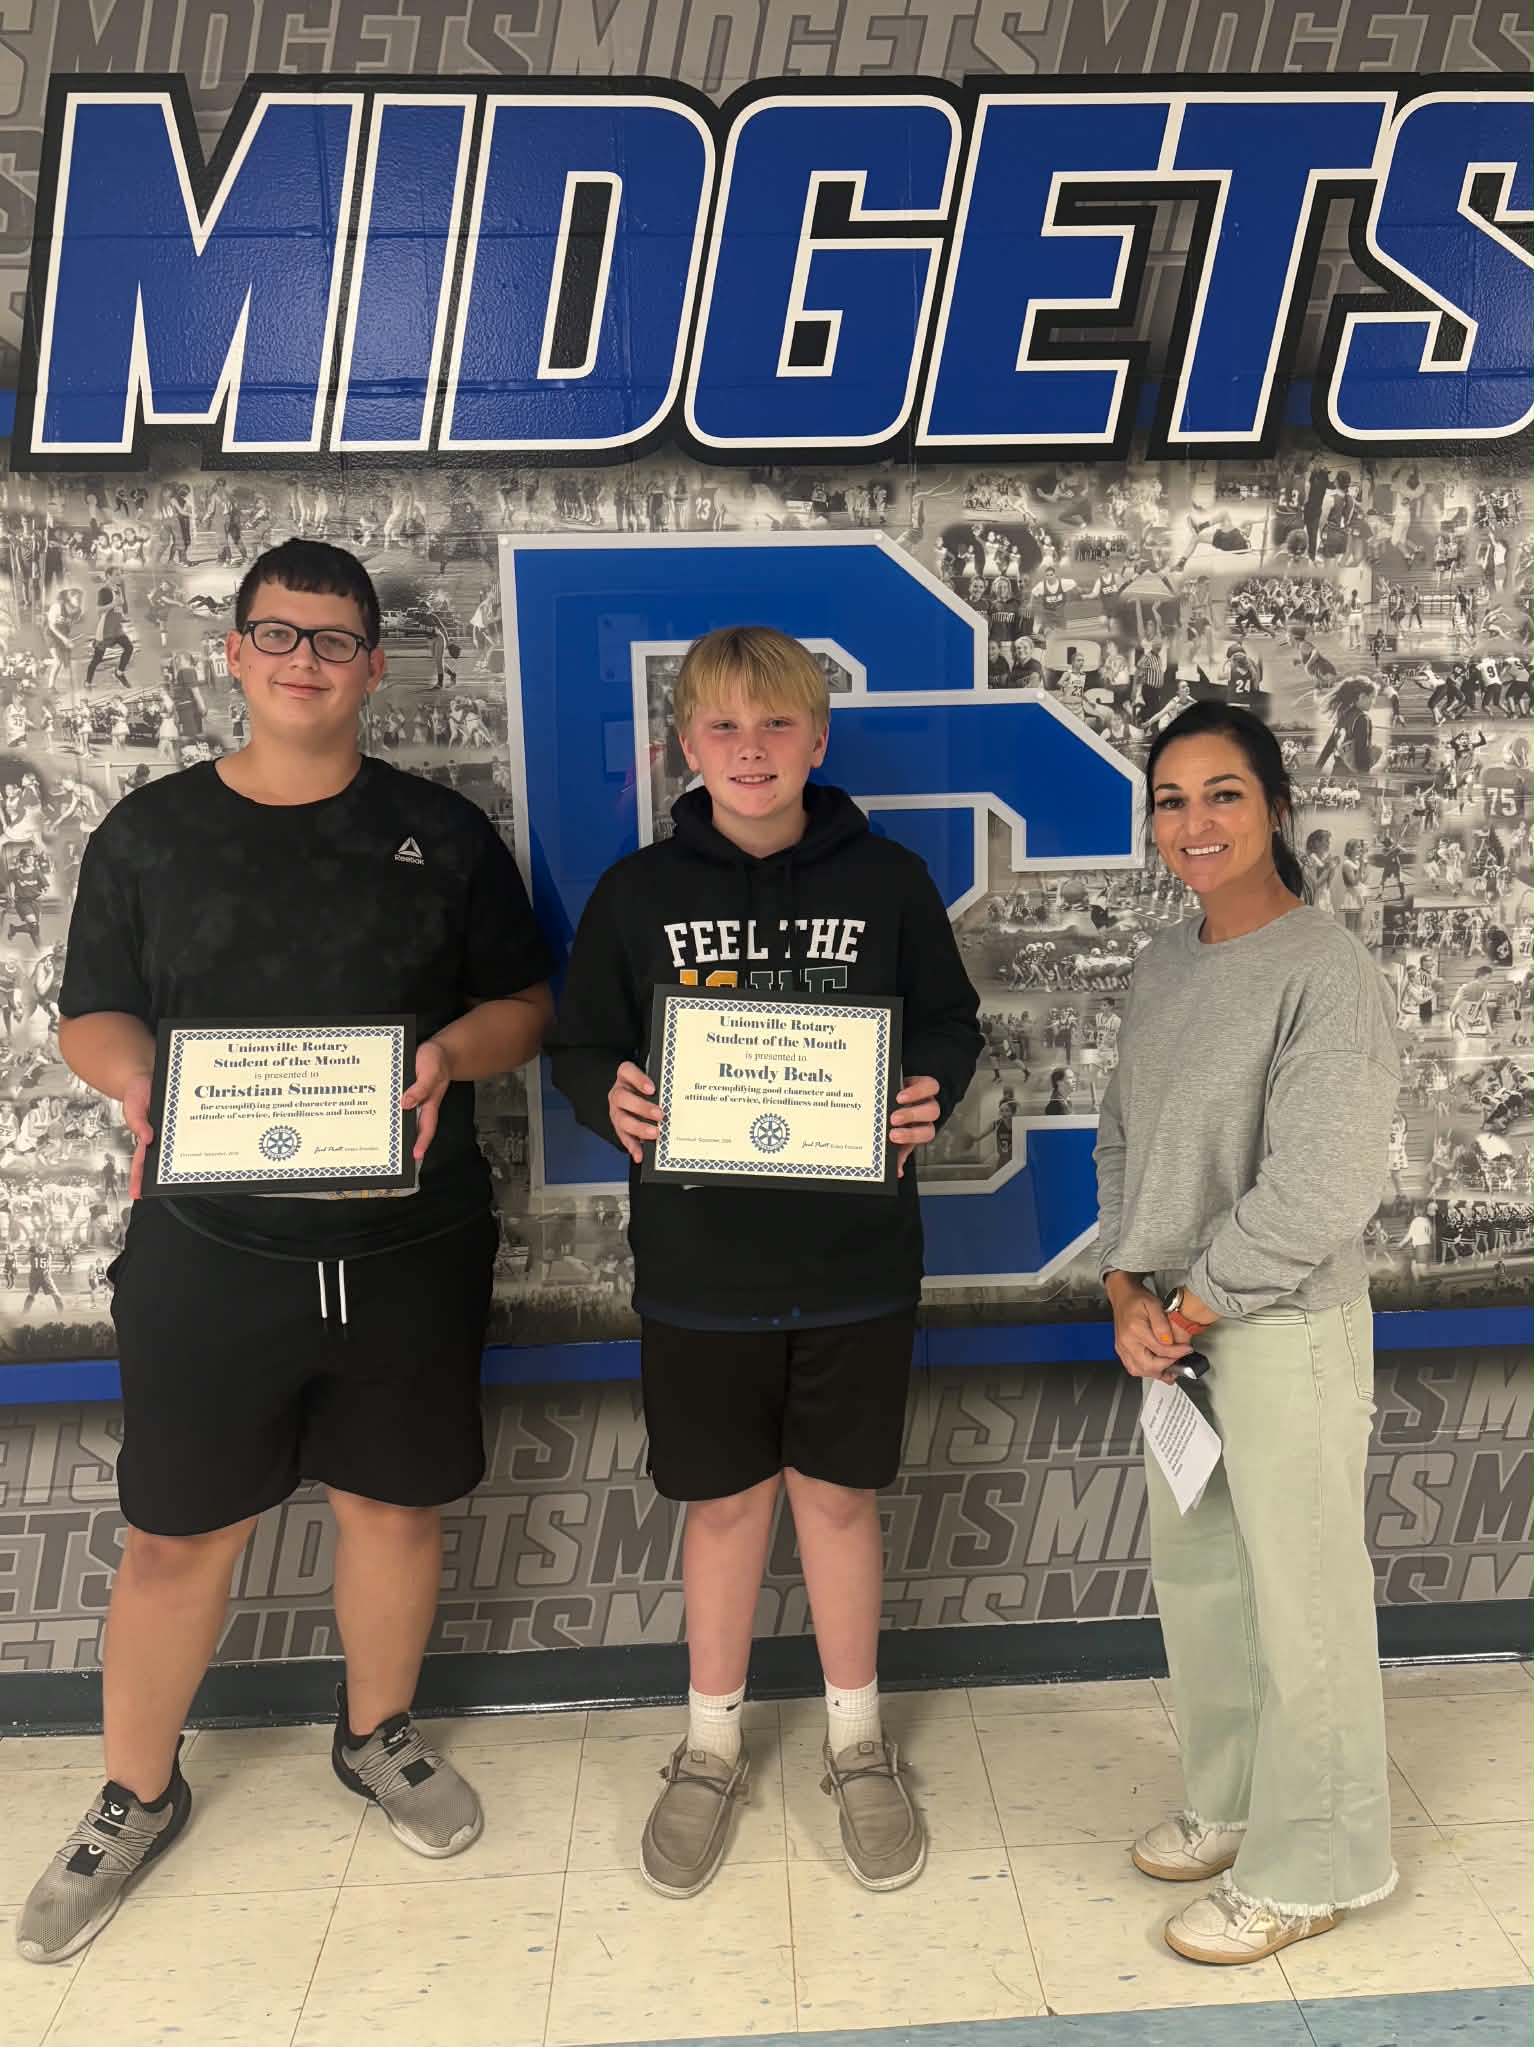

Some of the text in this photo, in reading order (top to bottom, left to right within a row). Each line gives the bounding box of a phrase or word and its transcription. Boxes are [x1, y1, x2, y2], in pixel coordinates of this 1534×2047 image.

[27, 89, 1534, 455] MIDGETS
[1487, 787, 1516, 816] 75
[664, 920, 768, 967] FEEL
[719, 1016, 836, 1034] Unionville Rotary
[227, 1042, 348, 1054] Unionville Rotary
[706, 1032, 847, 1050] Student of the Month
[214, 1056, 360, 1068] Student of the Month
[755, 1052, 796, 1063] presented
[264, 1071, 307, 1080] presented
[719, 1063, 832, 1083] Rowdy Beals
[194, 1082, 376, 1098] Christian Summers
[709, 1084, 761, 1094] exemplifying
[762, 1087, 782, 1096] good
[784, 1088, 824, 1096] character
[272, 1101, 293, 1110] good
[294, 1100, 337, 1108] character
[685, 1094, 719, 1102] attitude
[830, 1101, 862, 1110] honesty
